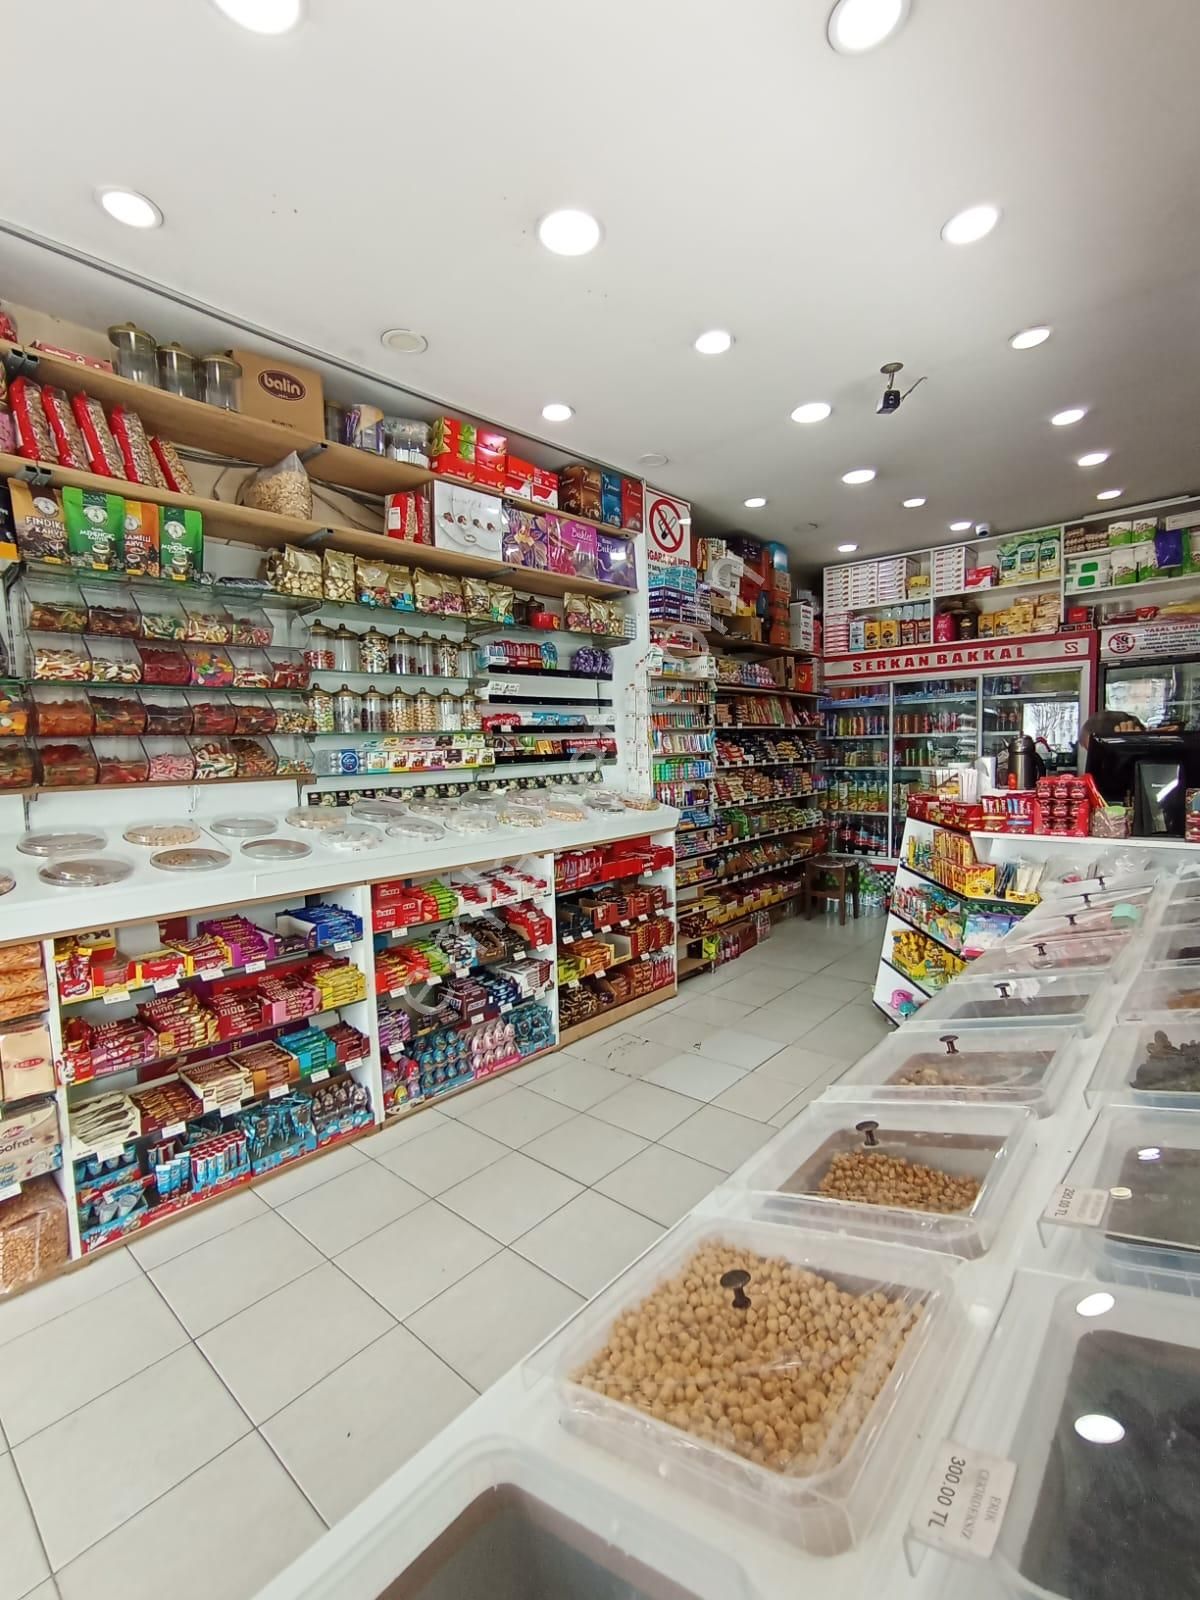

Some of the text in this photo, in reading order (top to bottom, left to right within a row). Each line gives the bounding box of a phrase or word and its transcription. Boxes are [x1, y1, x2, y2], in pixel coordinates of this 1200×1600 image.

[263, 373, 301, 396] balin
[852, 646, 1025, 673] SERKAN BAKKAL
[927, 1456, 966, 1528] 300.00 TL
